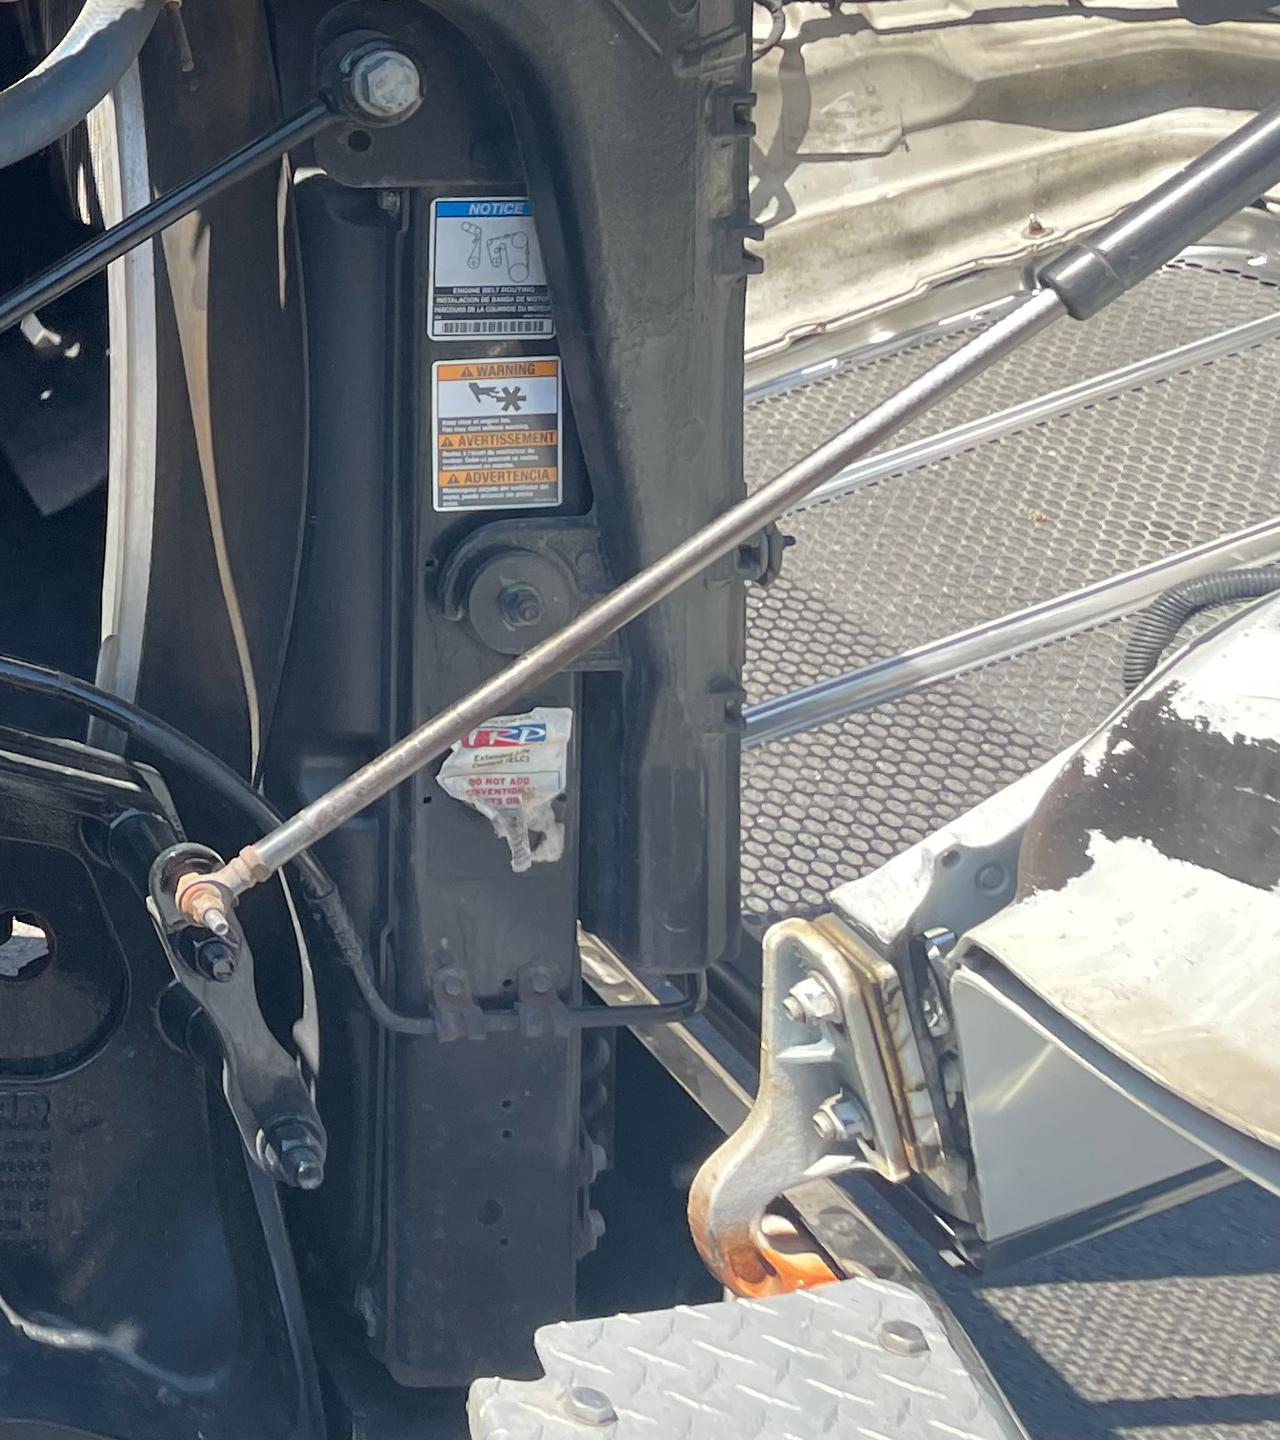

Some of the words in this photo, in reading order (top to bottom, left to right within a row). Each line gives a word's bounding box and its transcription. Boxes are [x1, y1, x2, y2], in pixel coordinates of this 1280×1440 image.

[468, 202, 525, 215] NOTICE
[476, 364, 536, 377] WARNING
[458, 431, 555, 447] AVERTISSEMENT
[464, 468, 550, 483] ADVERTENCIA
[485, 777, 506, 786] NOT
[510, 776, 530, 785] ADD
